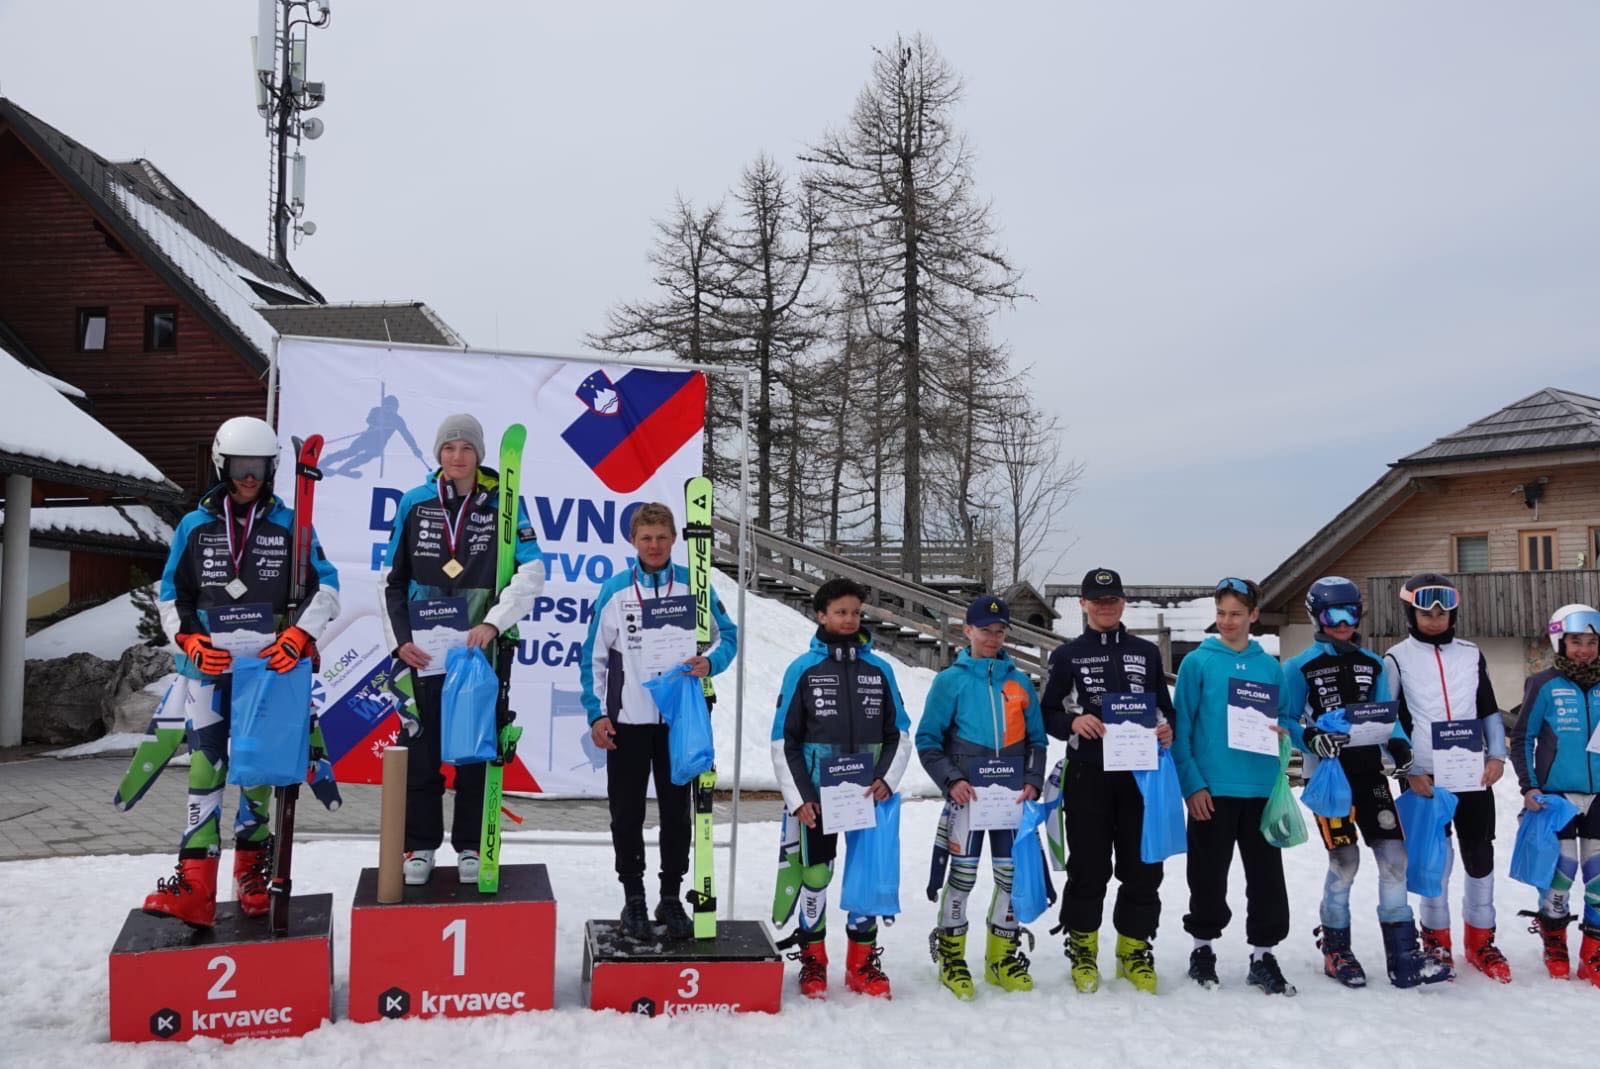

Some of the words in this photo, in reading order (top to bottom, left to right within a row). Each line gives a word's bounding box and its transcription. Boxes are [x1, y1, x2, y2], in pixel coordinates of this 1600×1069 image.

[502, 468, 514, 545] elan
[256, 535, 285, 547] COLMAR
[201, 570, 228, 578] ARGETA
[419, 607, 458, 617] DIPLOMA
[650, 605, 688, 616] DIPLOMA
[219, 612, 263, 622] DIPLOMA
[322, 648, 359, 682] SLOSKI
[1236, 687, 1272, 701] DIPLOMA
[1111, 703, 1148, 711] DIPLOMA
[1353, 708, 1389, 716] DIPLOMA
[1439, 729, 1473, 738] DIPLOMA
[829, 763, 865, 773] DIPLOMA
[979, 766, 1015, 775] DIPLOMA
[442, 919, 466, 977] 1
[207, 955, 237, 1000] 2
[677, 968, 700, 999] 3
[421, 990, 525, 1014] krvavec
[191, 1006, 293, 1031] krvavec
